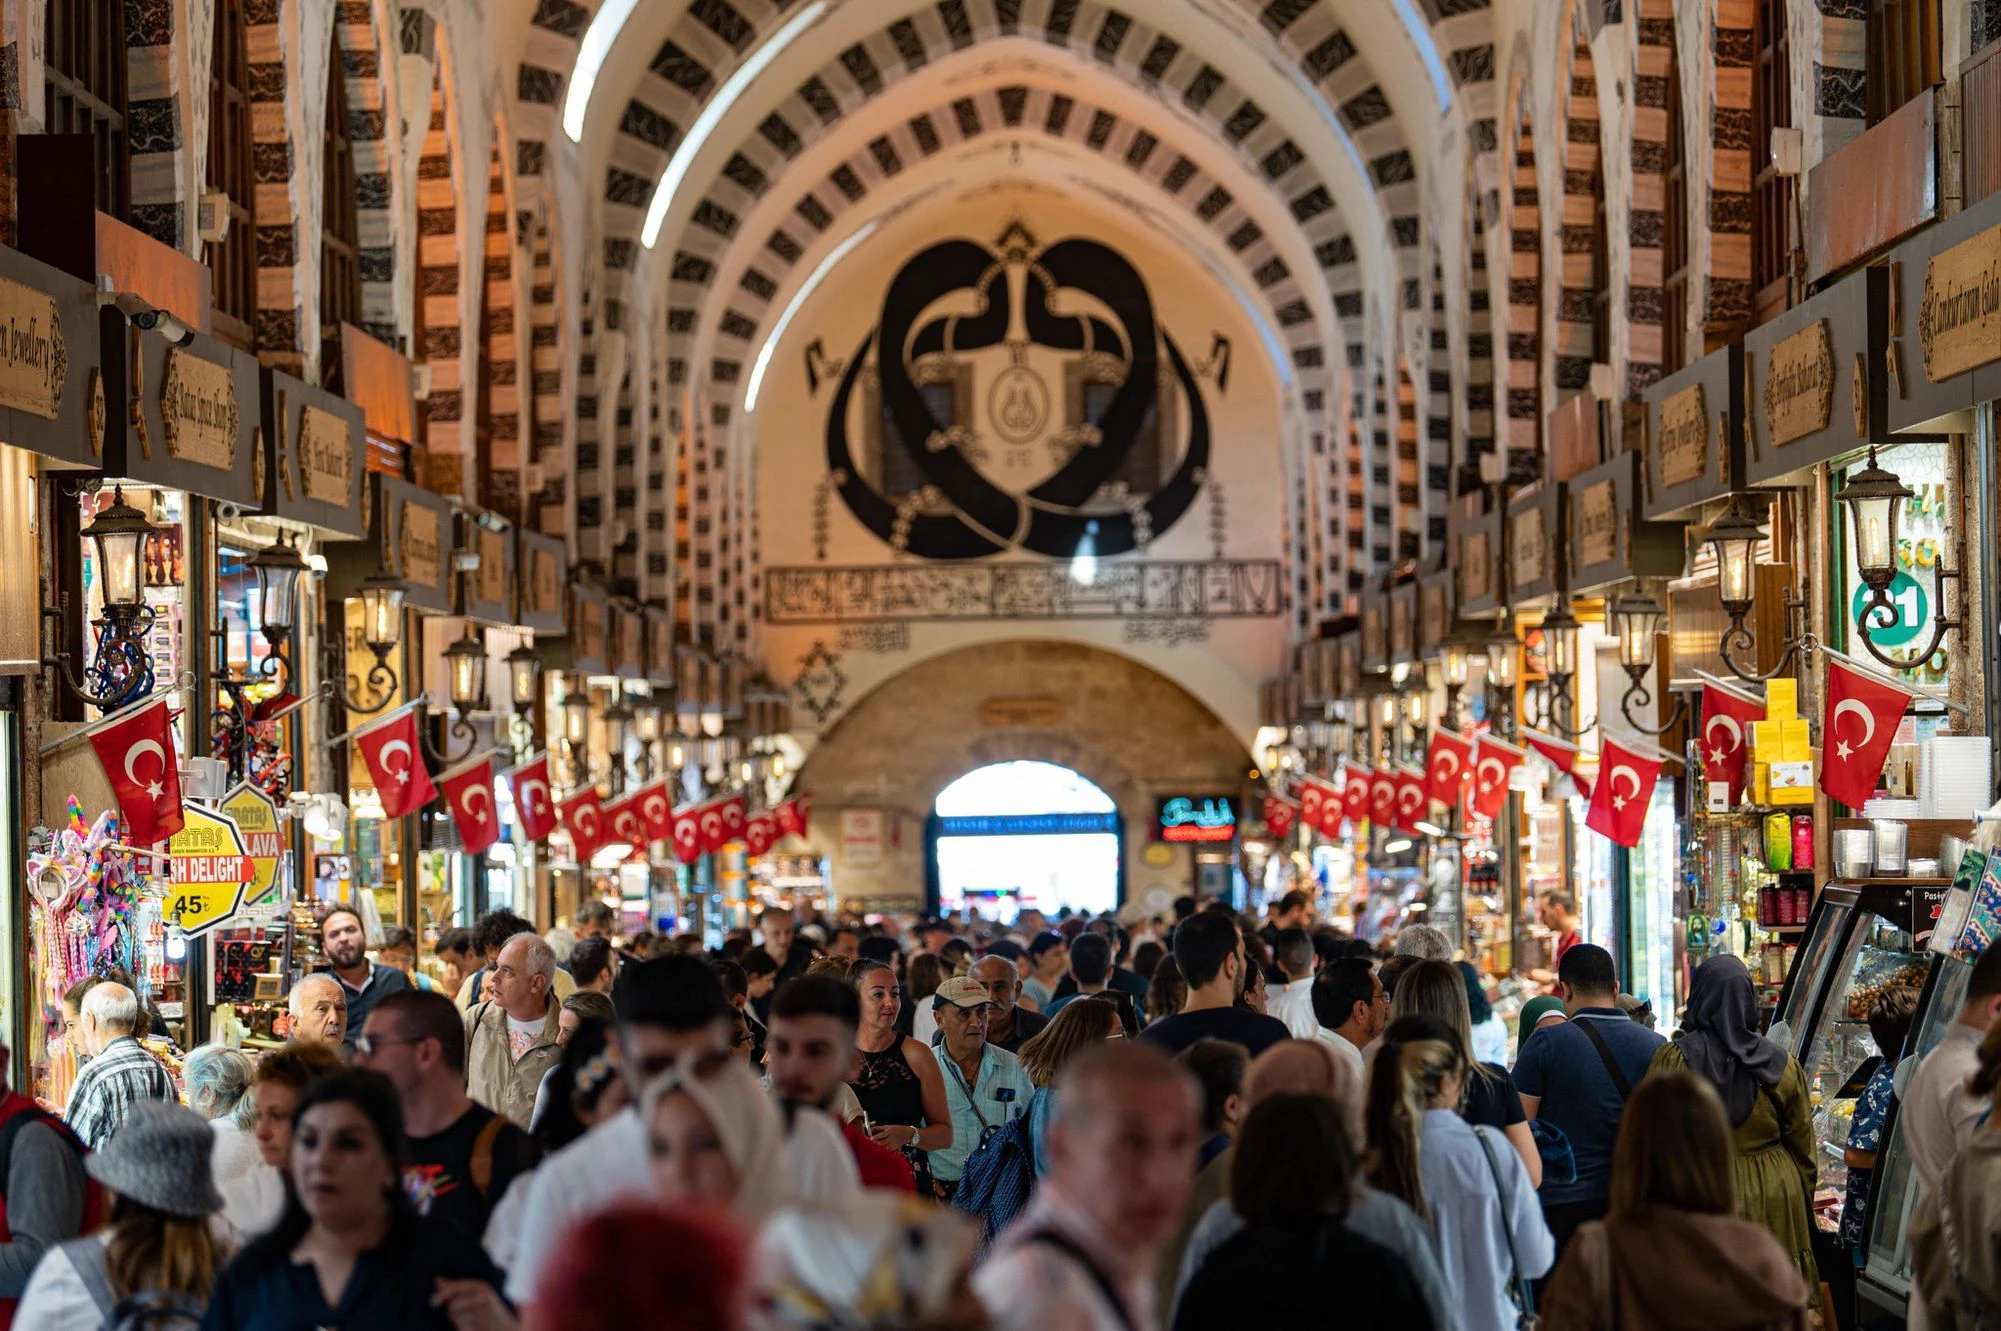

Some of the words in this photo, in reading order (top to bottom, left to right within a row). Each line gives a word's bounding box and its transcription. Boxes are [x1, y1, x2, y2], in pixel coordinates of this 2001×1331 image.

[8, 316, 50, 388] Jewellery
[243, 833, 279, 857] LAVA
[170, 857, 186, 882] SH
[190, 856, 244, 882] DELIGHT
[175, 895, 202, 914] 45
